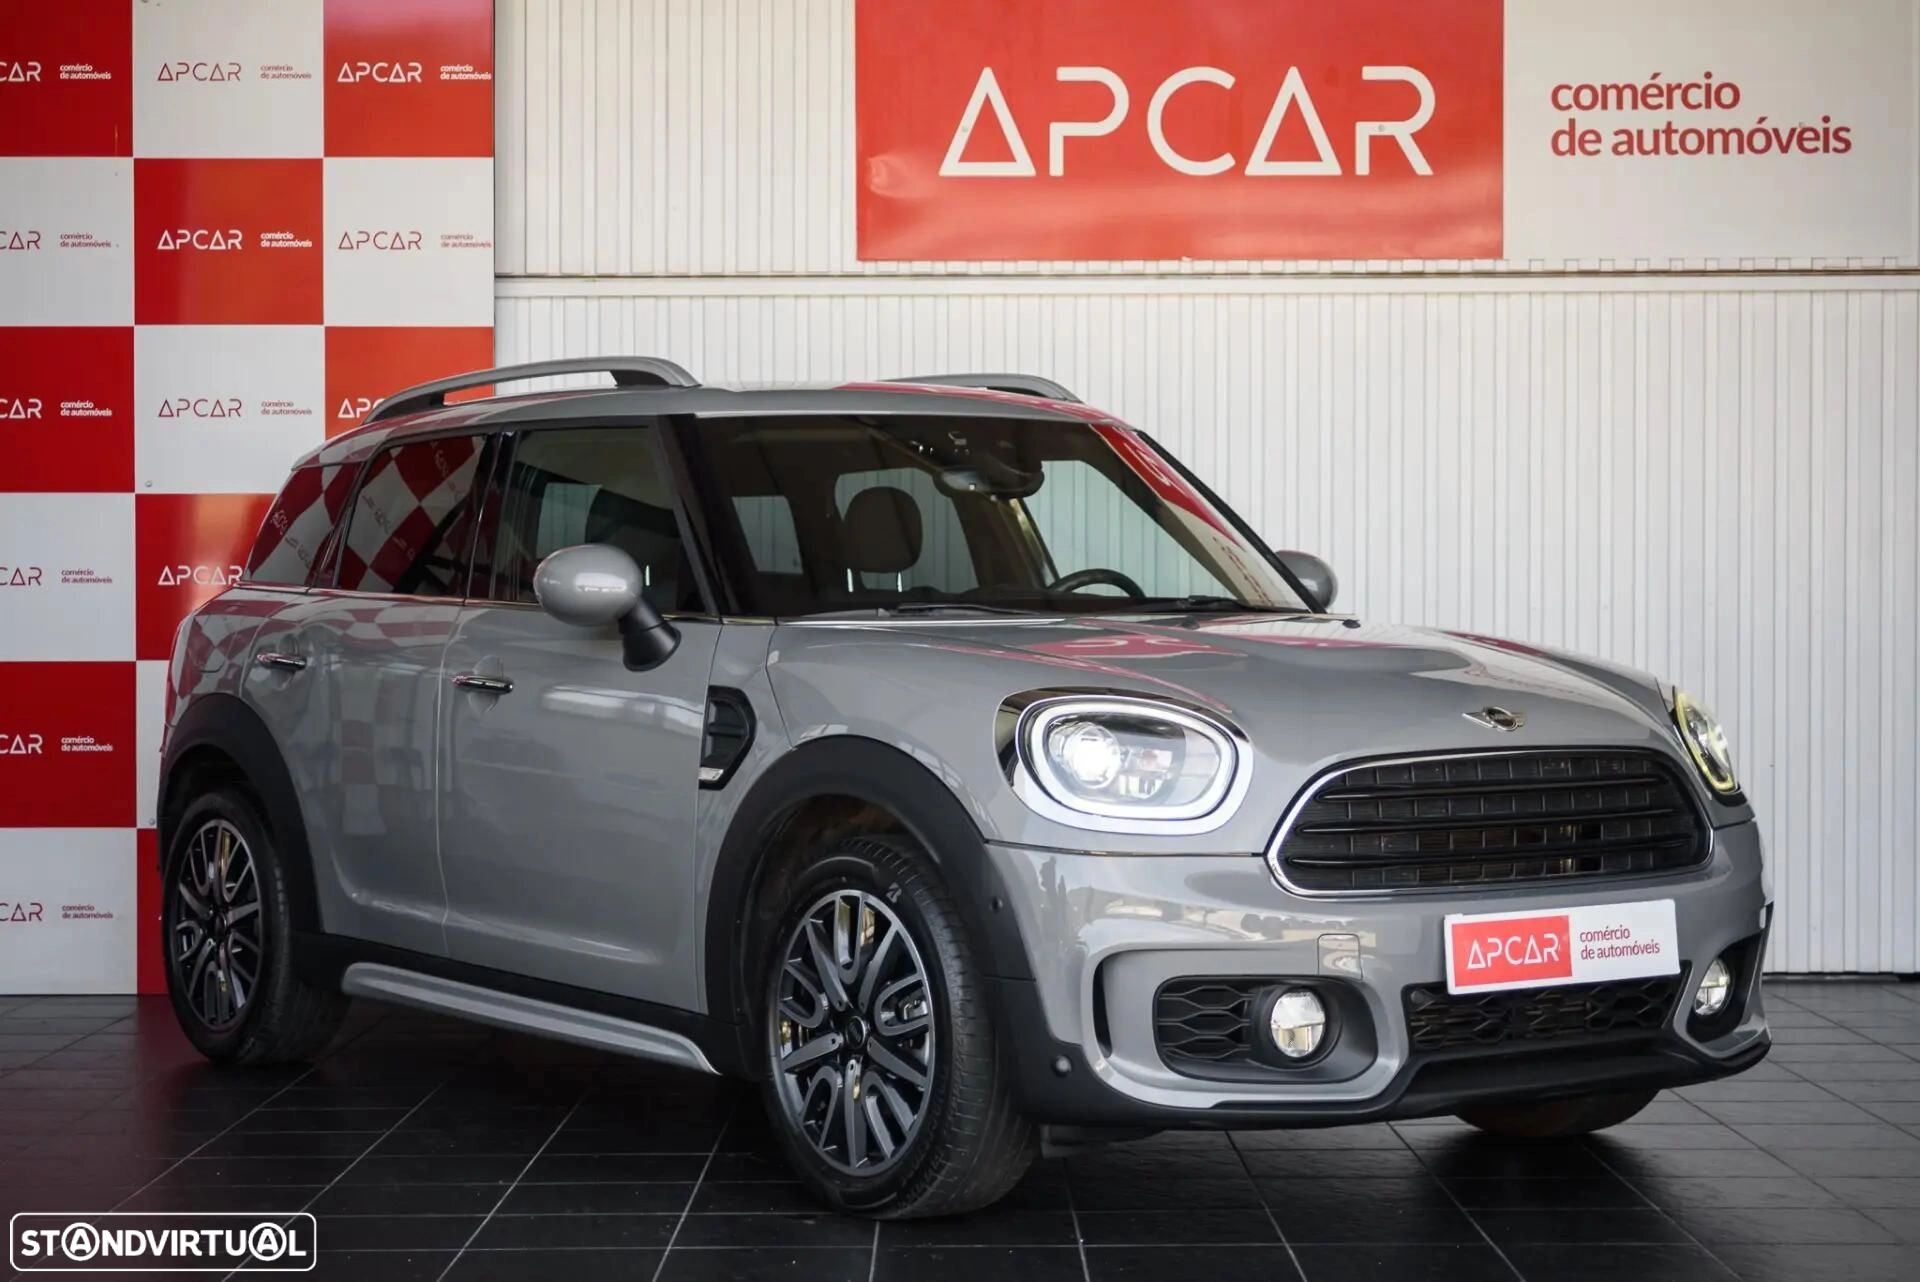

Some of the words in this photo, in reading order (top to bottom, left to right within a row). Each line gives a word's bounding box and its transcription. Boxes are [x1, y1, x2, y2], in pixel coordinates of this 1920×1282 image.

[59, 64, 93, 72] comércio
[59, 72, 69, 80] de
[69, 72, 112, 80] automóveis
[157, 62, 242, 82] APCAR
[337, 62, 423, 83] APCAR
[1551, 71, 1741, 111] comércio
[938, 66, 1436, 177] APCAR
[1551, 119, 1602, 157] de
[1611, 116, 1853, 156] automóveis
[157, 229, 243, 250] APCAR
[260, 232, 294, 240] comércio
[260, 240, 270, 248] de
[270, 240, 313, 248] automóveis
[337, 230, 423, 250] APCAR
[60, 400, 94, 408] comércio
[60, 408, 70, 416] de
[70, 408, 112, 416] automóveis
[157, 398, 243, 418] APCAR
[157, 565, 243, 586] APCAR
[1579, 925, 1630, 942] comércio
[1467, 933, 1560, 969] APCAR
[1580, 945, 1596, 960] de
[1597, 939, 1660, 958] automóveis
